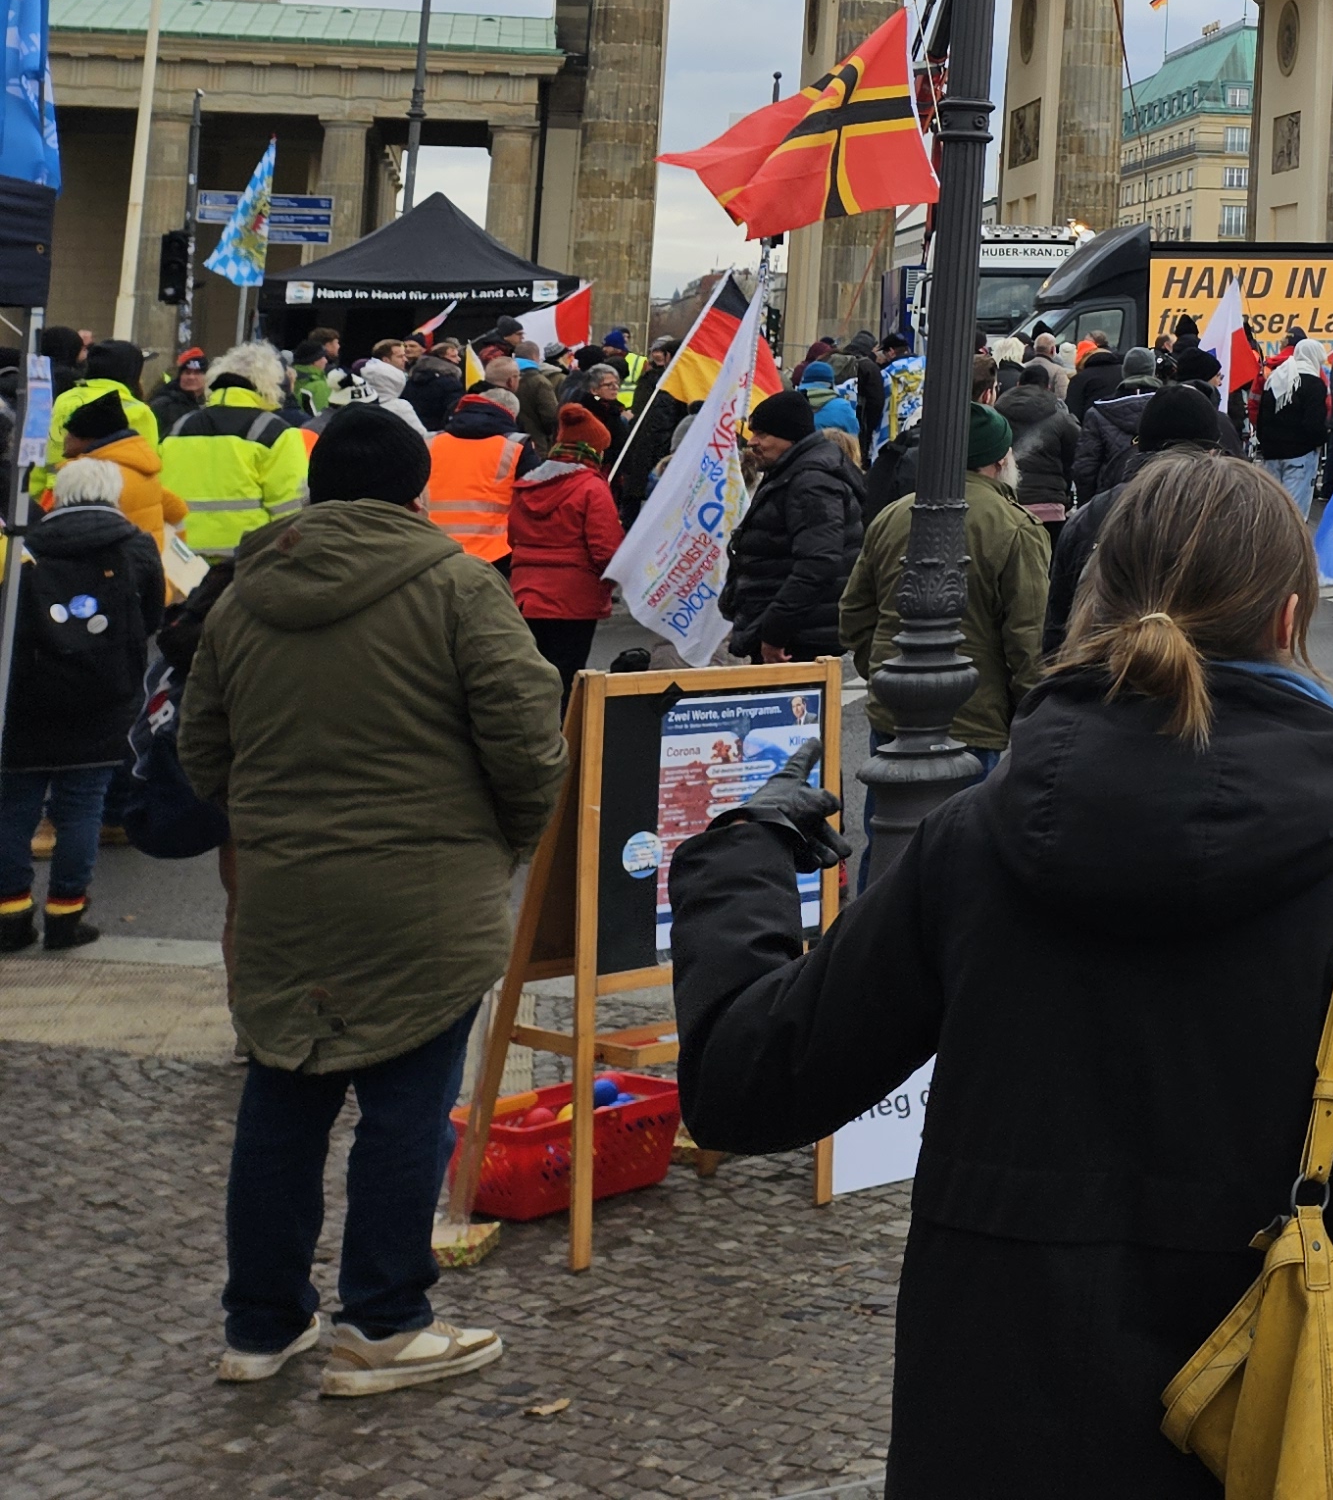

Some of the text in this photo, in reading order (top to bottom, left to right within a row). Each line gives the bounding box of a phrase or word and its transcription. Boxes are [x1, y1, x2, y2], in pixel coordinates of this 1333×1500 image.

[982, 248, 1070, 257] HUBER-KRAN.DE
[1161, 266, 1273, 299] HAND
[1285, 267, 1327, 299] IN
[316, 287, 352, 300] Hand
[355, 288, 369, 299] in
[471, 288, 503, 299] Land
[667, 711, 690, 722] Zwei
[692, 709, 720, 721] Worte,
[721, 707, 735, 718] ein
[666, 745, 701, 757] Corona
